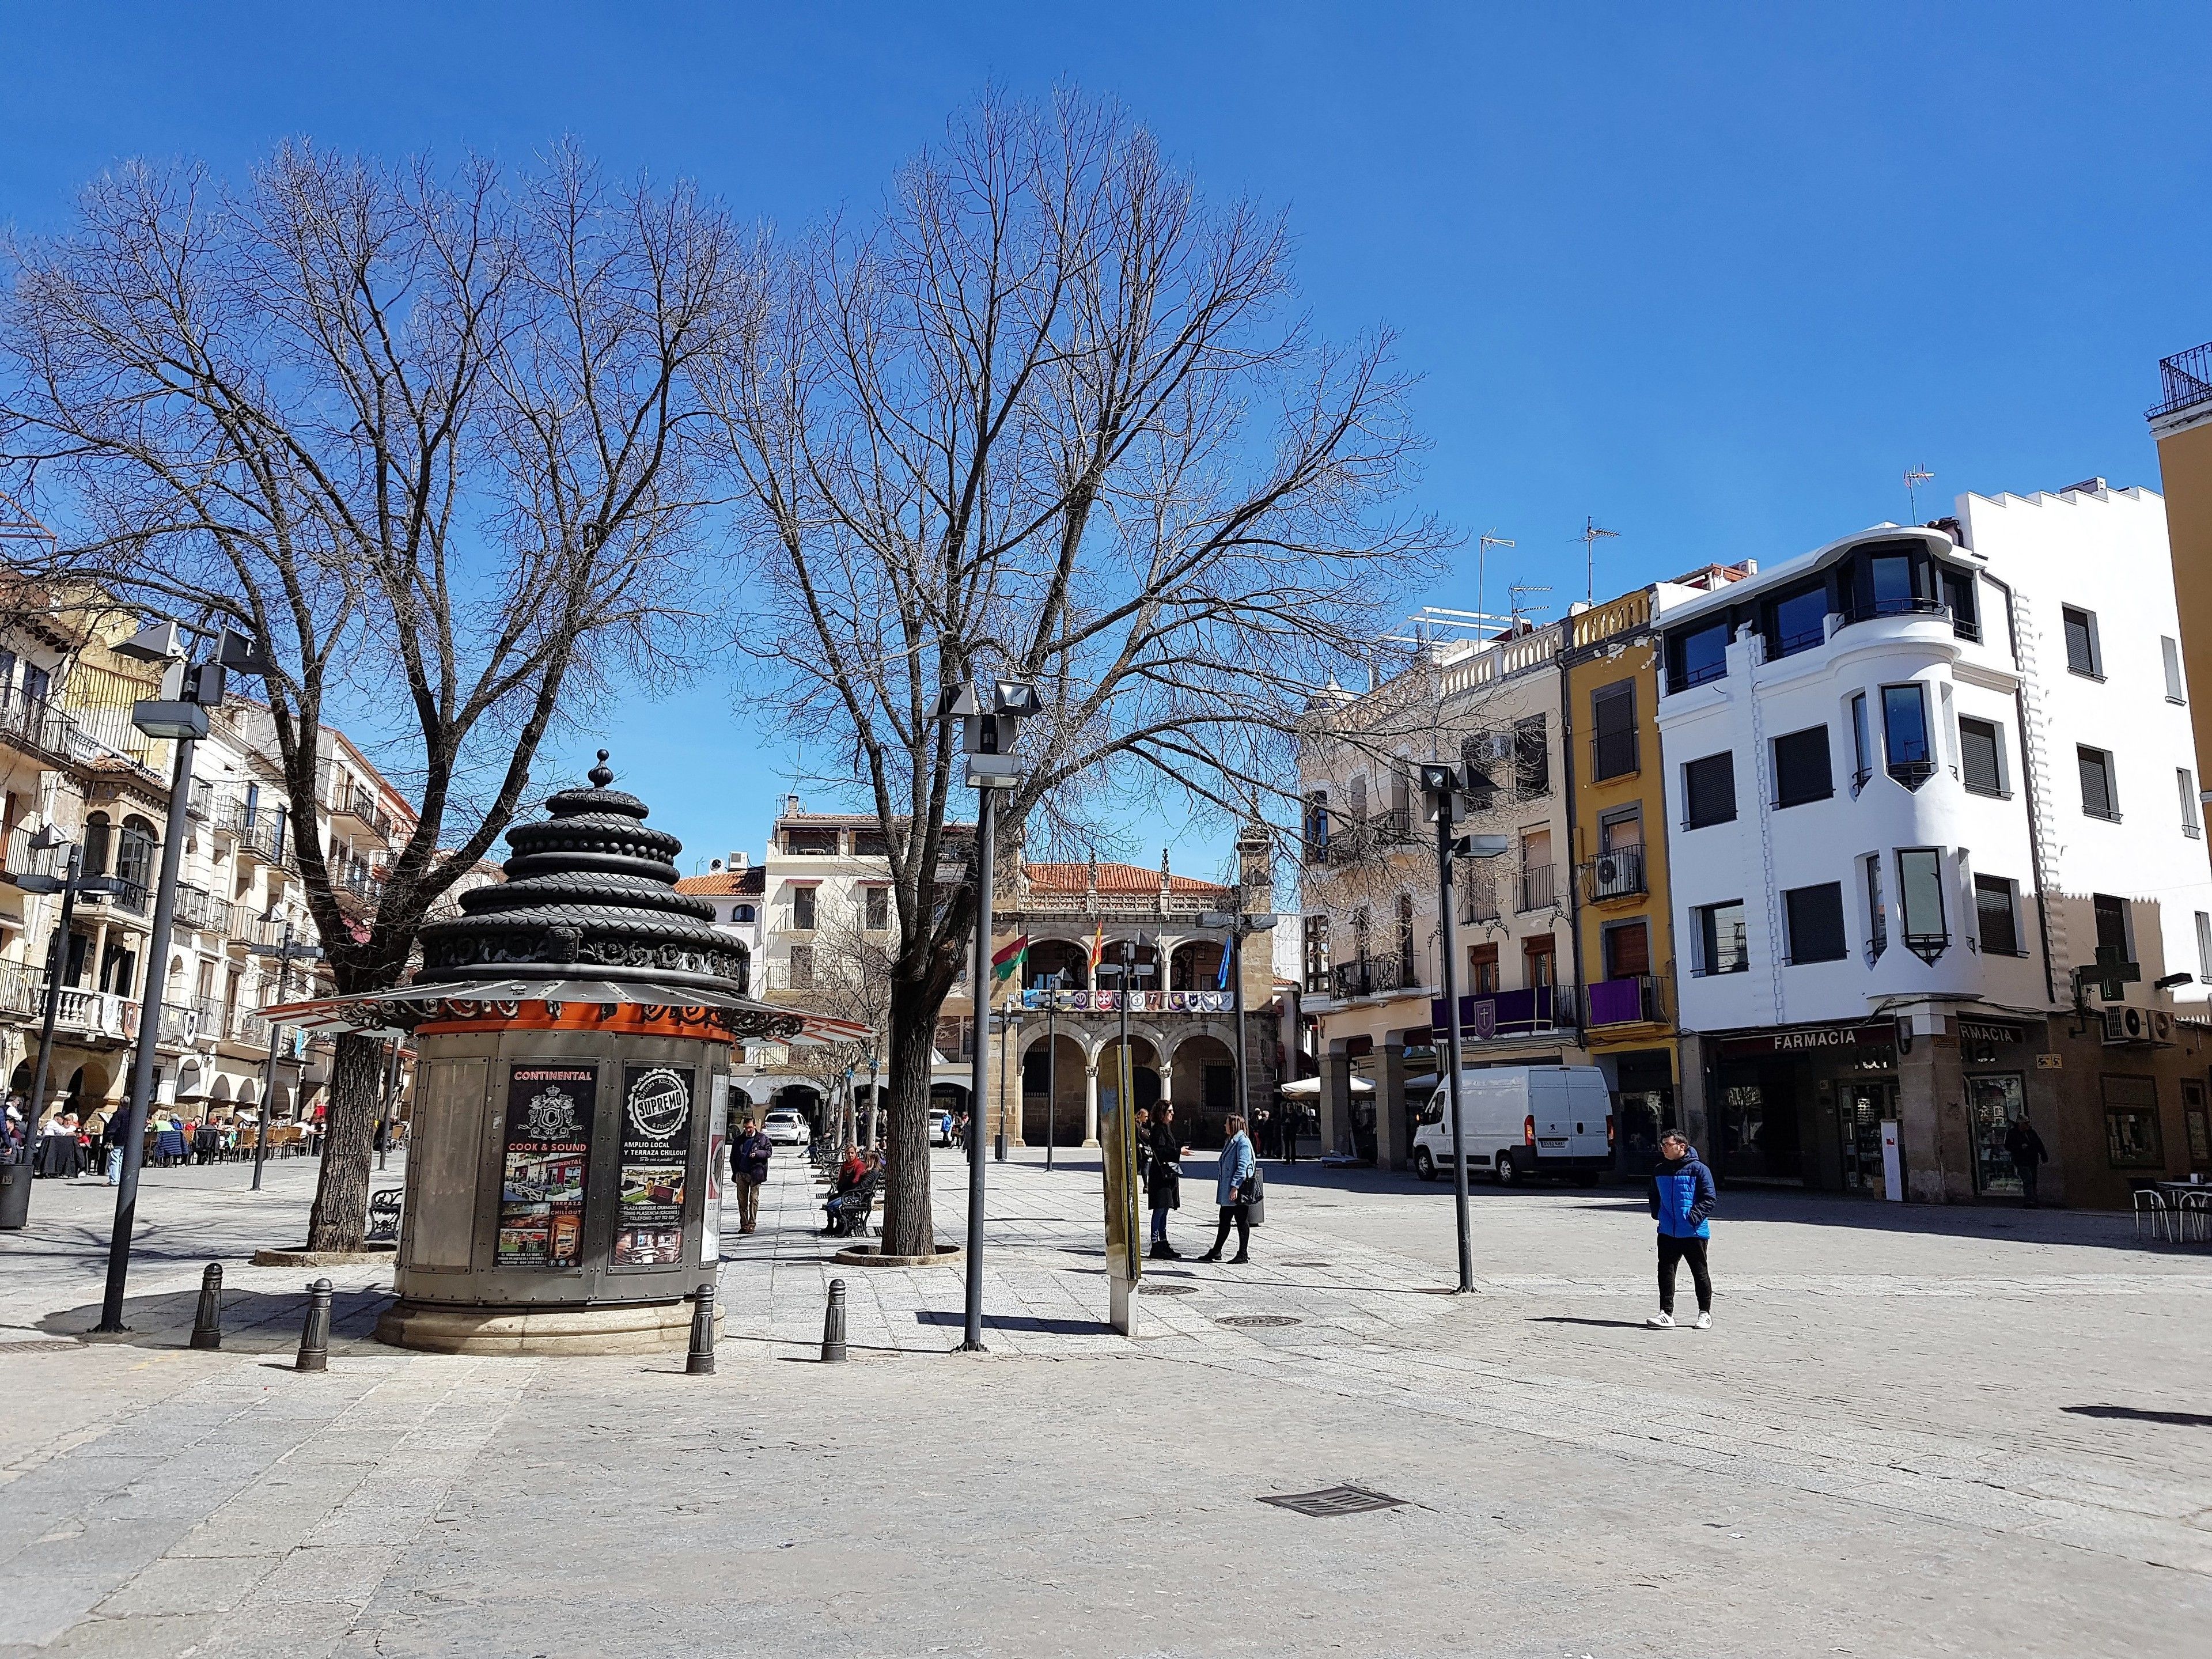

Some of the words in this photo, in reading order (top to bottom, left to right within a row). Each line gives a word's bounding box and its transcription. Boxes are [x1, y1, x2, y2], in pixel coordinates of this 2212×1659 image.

[1774, 1030, 1856, 1050] FARMACIA
[1959, 1025, 2014, 1043] RMACIA
[514, 1071, 592, 1081] CONTINENTAL
[637, 1091, 682, 1117] SUPREMO
[551, 1143, 586, 1152] SOUND
[547, 1159, 582, 1168] CONTINENTAL
